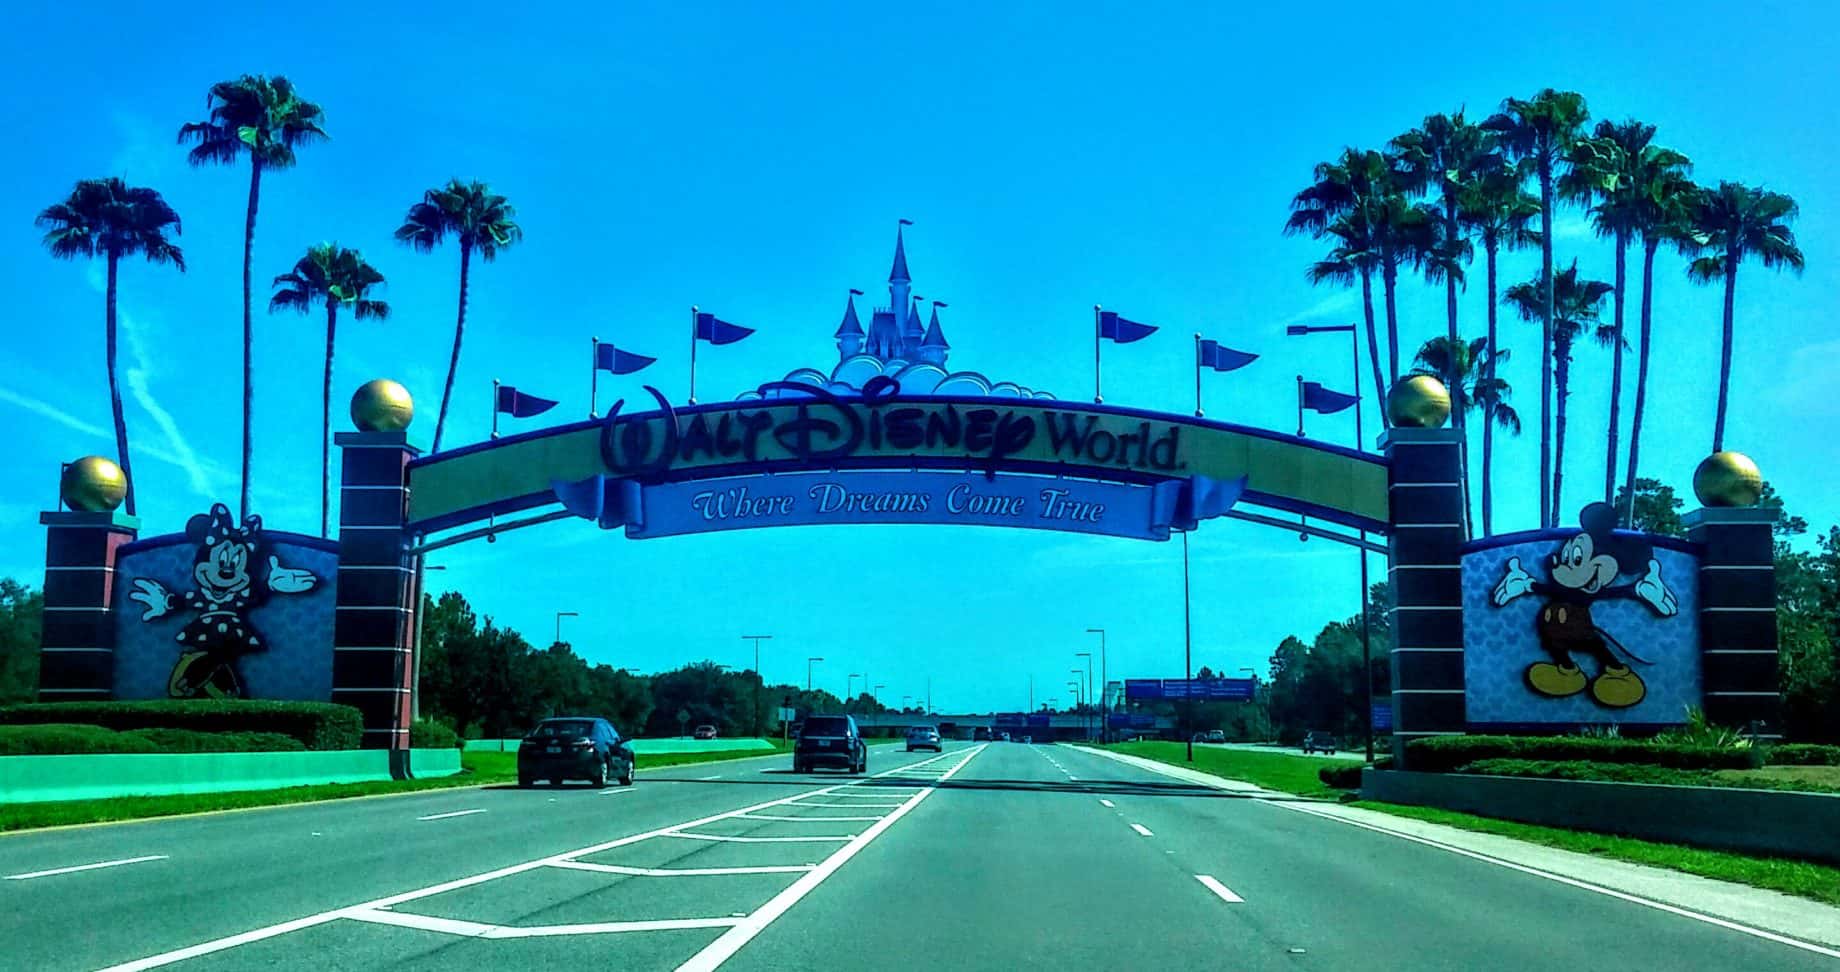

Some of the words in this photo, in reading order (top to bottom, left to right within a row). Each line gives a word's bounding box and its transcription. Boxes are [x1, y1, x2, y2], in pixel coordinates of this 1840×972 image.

[693, 489, 795, 520] Where
[809, 484, 931, 515] Dreams
[946, 484, 1025, 517] Come
[1039, 488, 1106, 523] True
